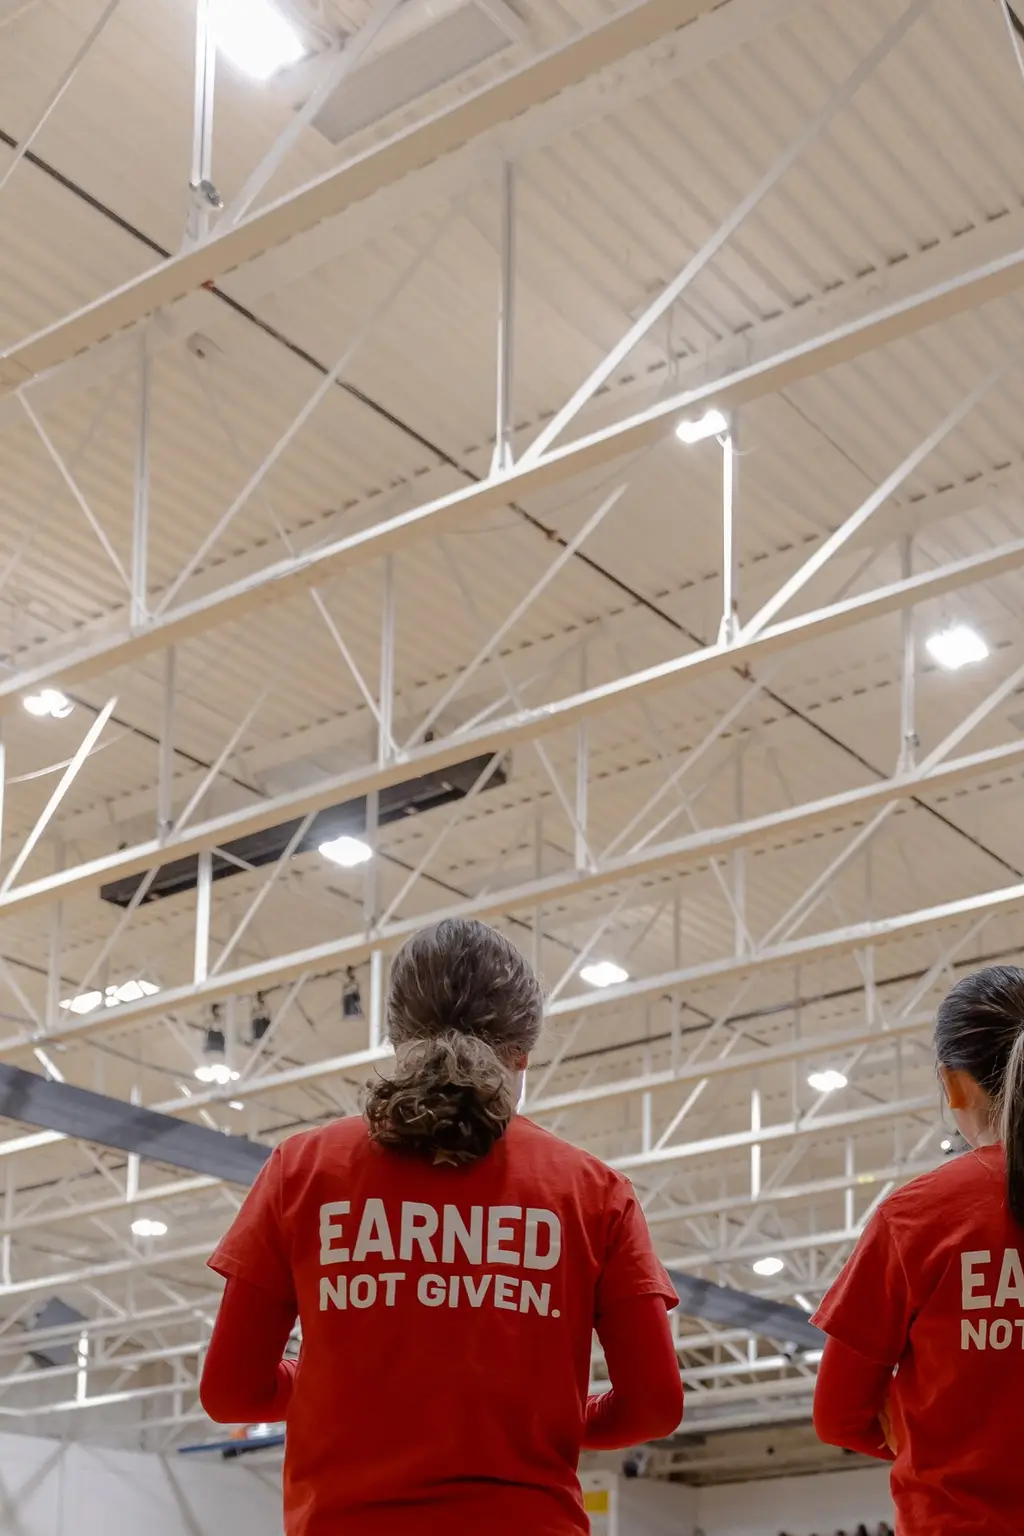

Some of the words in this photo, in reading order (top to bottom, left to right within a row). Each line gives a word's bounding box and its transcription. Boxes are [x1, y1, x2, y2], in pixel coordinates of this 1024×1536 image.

[319, 1198, 561, 1270] EARNED
[319, 1272, 405, 1311] NOT
[417, 1273, 560, 1318] GIVEN.
